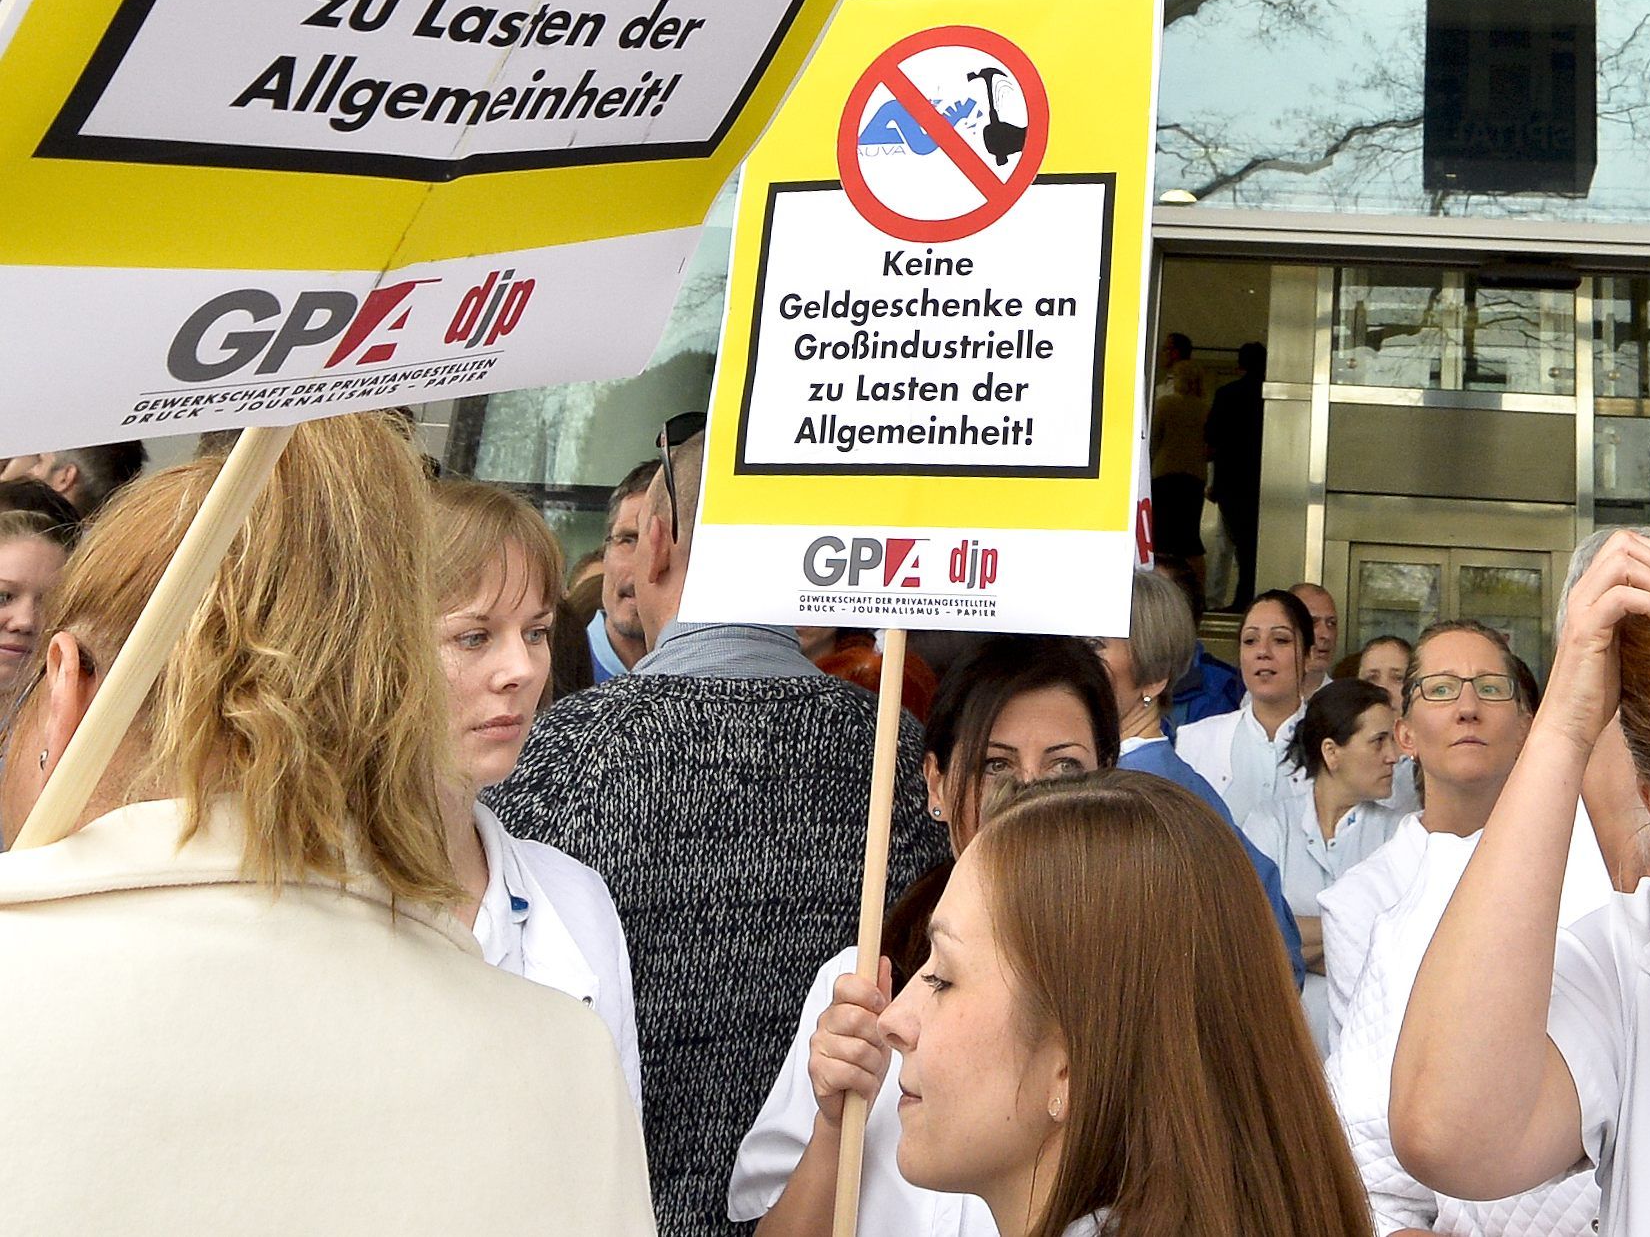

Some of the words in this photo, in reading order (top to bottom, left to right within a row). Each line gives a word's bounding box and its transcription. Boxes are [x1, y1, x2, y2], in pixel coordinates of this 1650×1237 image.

[229, 54, 683, 133] Allgemeinheit!
[883, 248, 973, 276] Keine
[167, 278, 441, 383] GPA
[444, 268, 536, 349] djp
[779, 288, 1023, 326] Geldgeschenke
[1035, 297, 1076, 316] an
[794, 329, 1053, 360] Großindustrielle
[121, 407, 204, 426] DRUCK
[234, 384, 400, 413] JOURNALISMUS
[424, 370, 488, 389] PAPIER
[133, 386, 291, 413] GEWERKSCHAFT
[292, 381, 328, 395] DER
[330, 358, 498, 392] PRIVATANGESTELLTEN
[808, 383, 843, 401] zu
[856, 374, 958, 401] Lasten
[972, 372, 1029, 401] der
[794, 414, 1033, 453] Allgemeinheit!
[803, 535, 930, 588] GPA
[949, 539, 998, 590] djp
[799, 595, 872, 605] GEWERKSCHAFT
[875, 597, 893, 606] DER
[895, 597, 996, 609] PRIVATANGESTELLTEN
[799, 604, 836, 613] DRUCK
[852, 605, 940, 616] JOURNALISMUS
[956, 608, 996, 617] PAPIER
